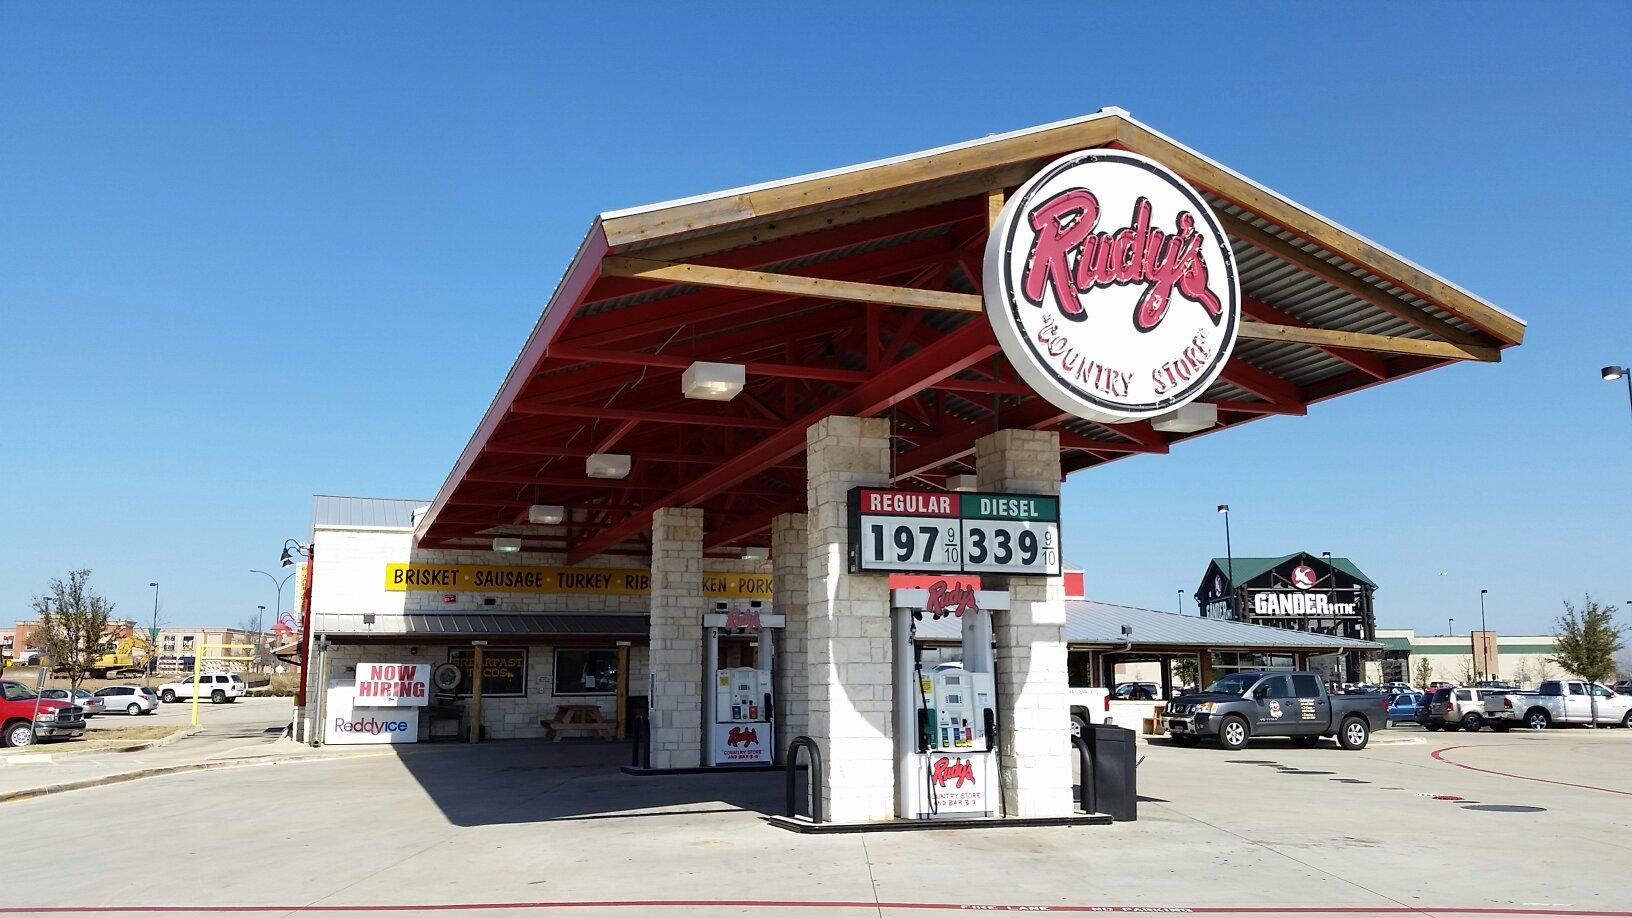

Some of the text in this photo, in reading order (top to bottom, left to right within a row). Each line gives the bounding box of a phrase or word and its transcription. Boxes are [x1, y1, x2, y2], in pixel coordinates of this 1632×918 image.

[1021, 186, 1223, 333] Rudy's
[870, 493, 950, 514] REGULAR
[980, 498, 1039, 517] DIESEL
[871, 524, 939, 563] 197
[968, 527, 1038, 566] 339
[393, 568, 460, 586] BRISKET
[474, 570, 543, 588] SAUSAGE
[558, 572, 612, 589] TURKEY
[625, 574, 652, 590] RIB
[738, 577, 773, 594] PORK
[926, 580, 980, 617] Rudy's
[1254, 593, 1329, 615] GANDER
[712, 630, 717, 639] 2
[371, 665, 417, 681] NOW
[453, 658, 523, 667] BREKFAST
[465, 668, 508, 677] TCOS
[359, 681, 425, 698] HIRING
[932, 756, 976, 789] Rudy's
